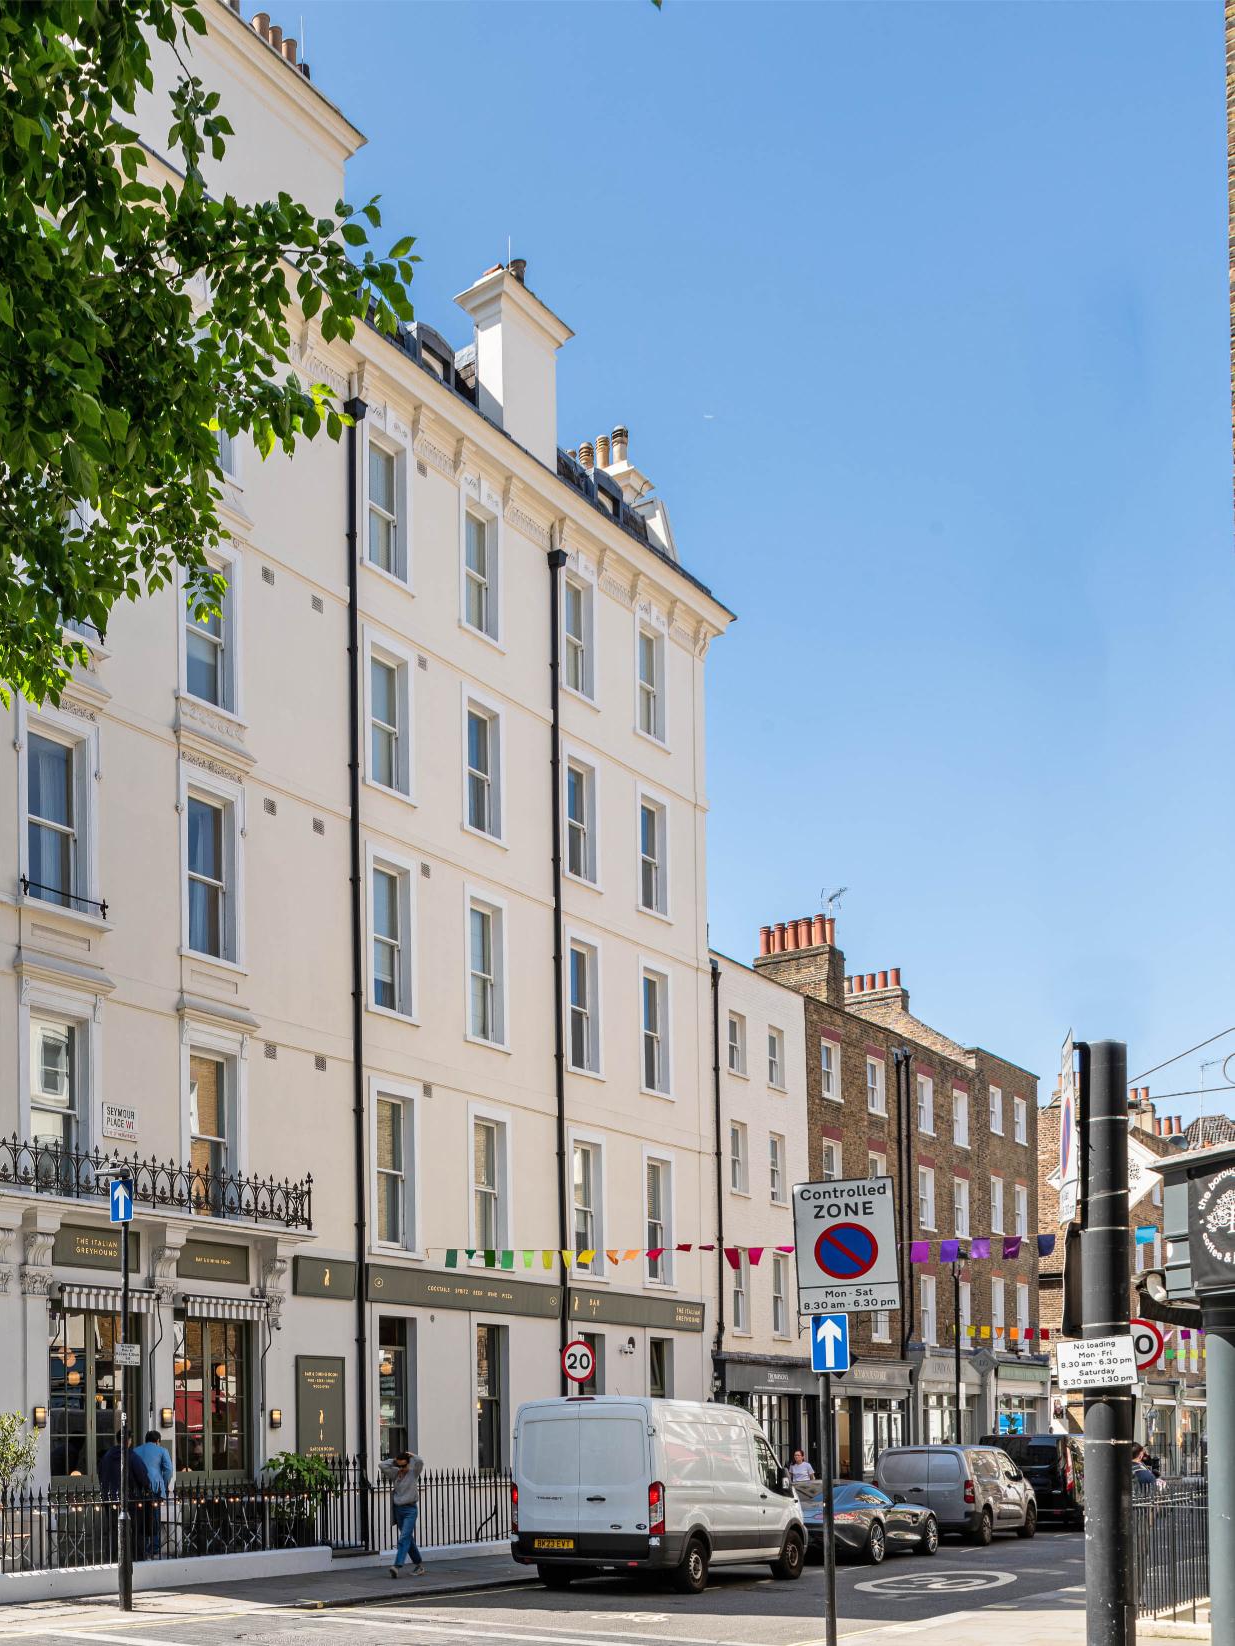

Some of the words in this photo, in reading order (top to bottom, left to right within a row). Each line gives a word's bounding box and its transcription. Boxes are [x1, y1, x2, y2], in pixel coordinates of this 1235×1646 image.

[106, 1106, 134, 1120] SEYMOUR
[106, 1117, 124, 1128] PLACE
[800, 1183, 886, 1201] Controlled
[1198, 1191, 1211, 1210] the
[814, 1201, 874, 1219] ZONE
[92, 1240, 118, 1248] ITALIAN
[1202, 1232, 1222, 1260] coffee
[1224, 1252, 1231, 1263] &
[76, 1246, 118, 1256] GREYHOUND
[826, 1290, 846, 1298] Mon
[855, 1288, 873, 1296] Sat
[590, 1298, 600, 1306] BAR
[804, 1302, 828, 1310] 8.30
[854, 1298, 878, 1308] 6.30
[880, 1298, 896, 1307] pm
[1134, 1334, 1154, 1354] 0
[568, 1353, 590, 1370] 20
[1079, 1368, 1116, 1376] Saturday
